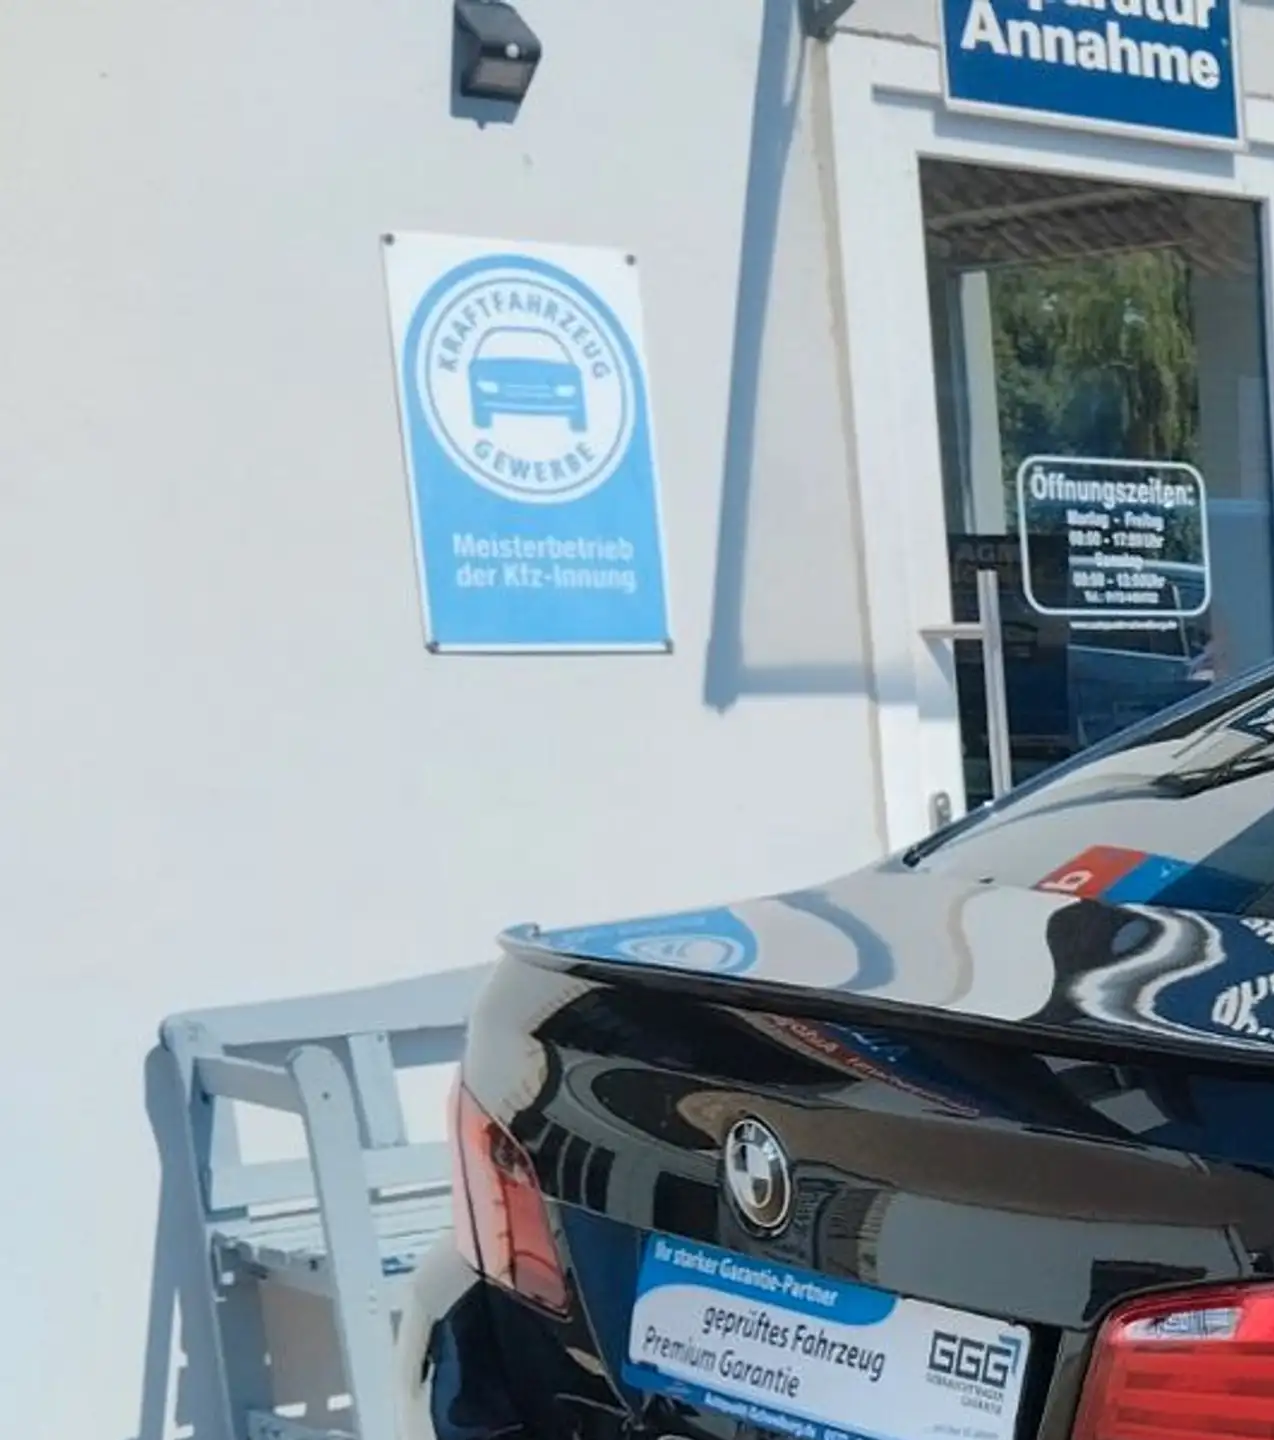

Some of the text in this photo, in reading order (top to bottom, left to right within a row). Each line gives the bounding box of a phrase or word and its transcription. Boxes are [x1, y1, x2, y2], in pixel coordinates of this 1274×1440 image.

[960, 0, 1221, 89] Annahme
[437, 289, 612, 382] KRAFTFAHRZEUG
[472, 439, 597, 483] GEWERBE
[1030, 465, 1196, 509] Öffnungszeiten:
[452, 532, 634, 561] Meisterbetrieb
[456, 562, 637, 593] der Kfz-Innung
[673, 1248, 719, 1274] starker
[720, 1257, 839, 1306] Garantie-Partner
[642, 1325, 800, 1398] Premium Garantie
[702, 1305, 886, 1382] geprüftes Fahrzeug
[928, 1329, 1013, 1389] GGG
